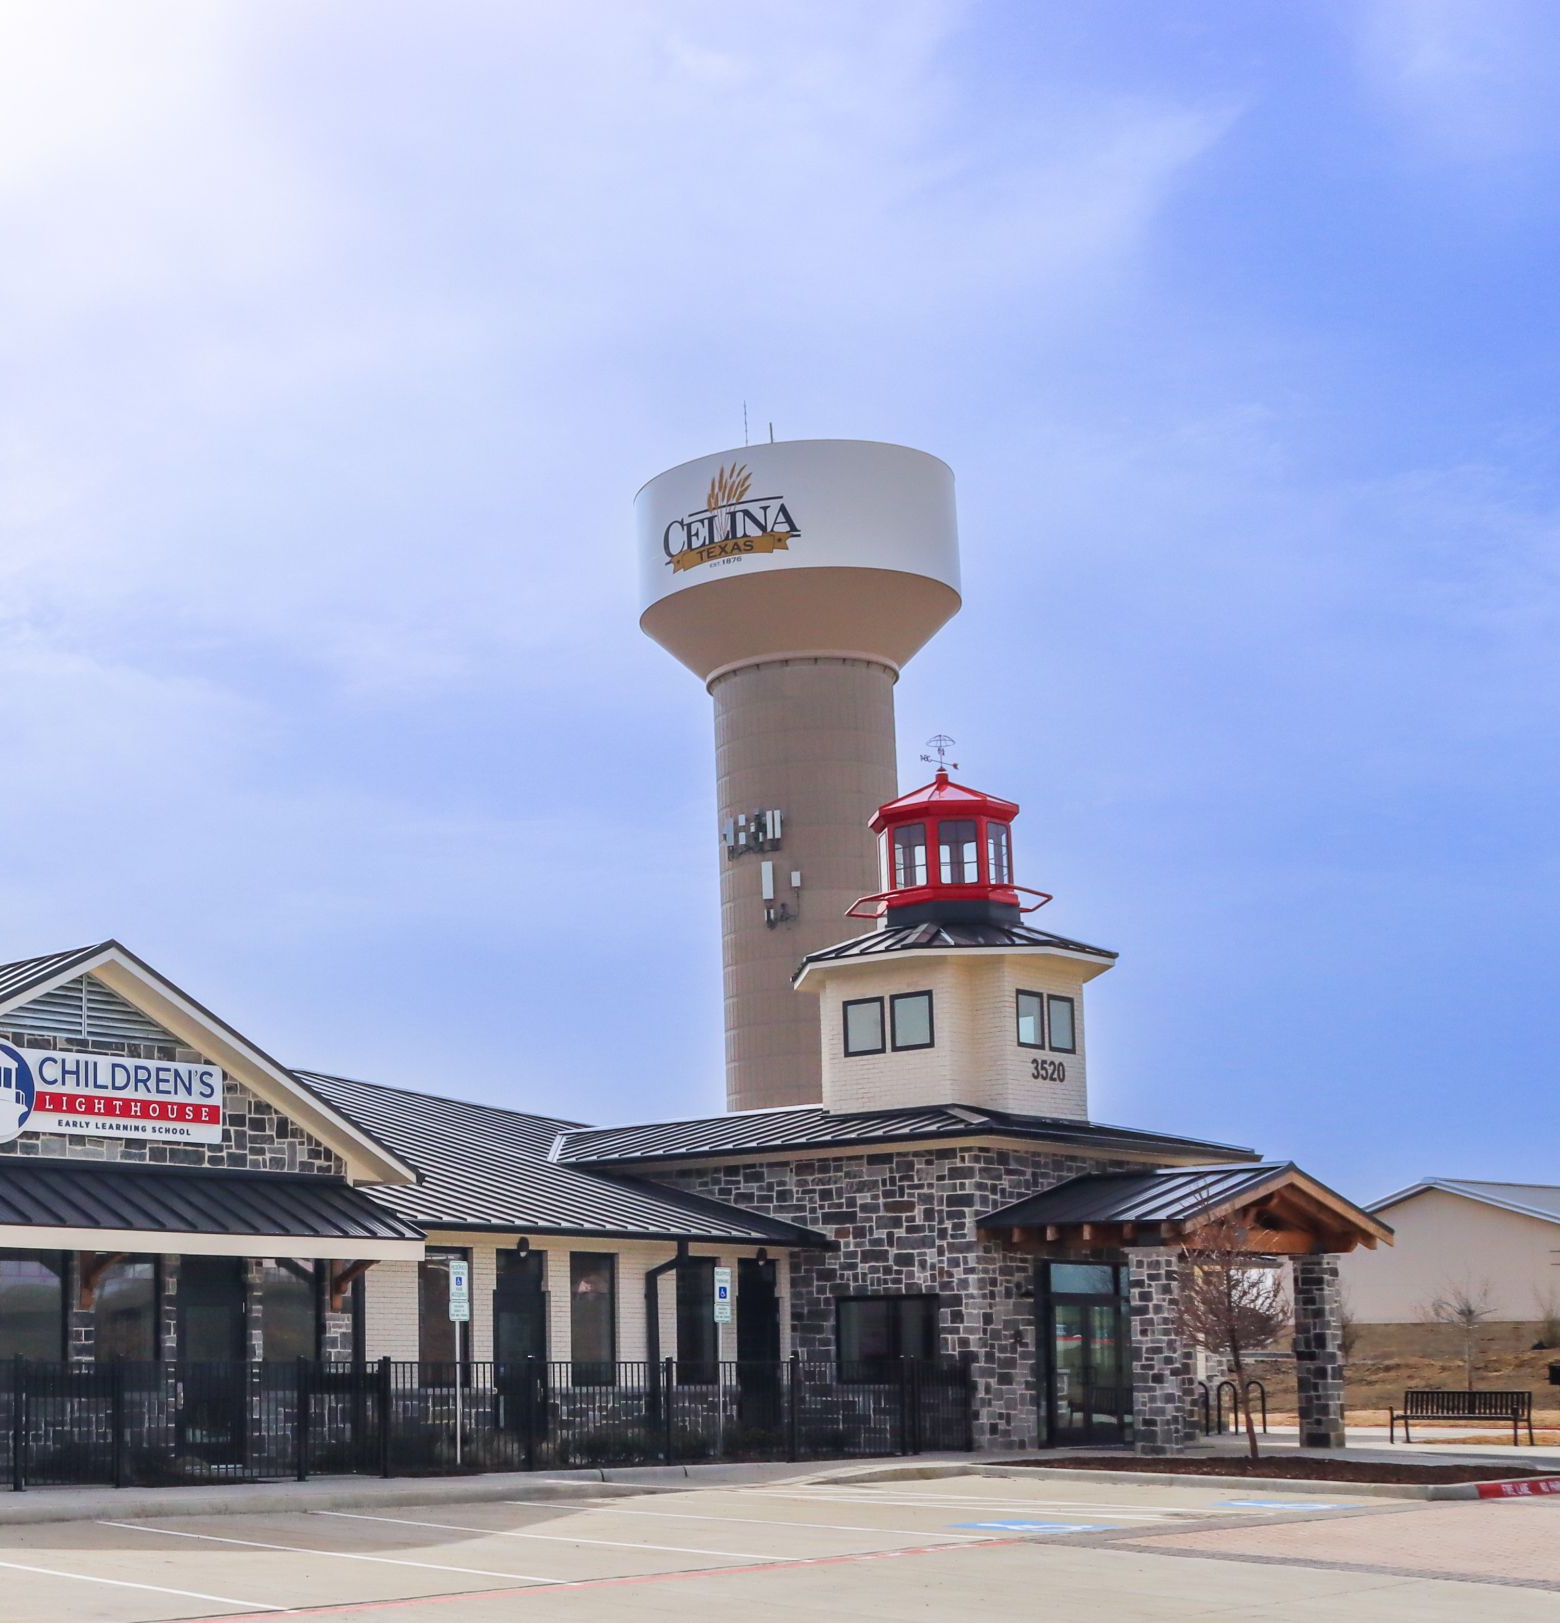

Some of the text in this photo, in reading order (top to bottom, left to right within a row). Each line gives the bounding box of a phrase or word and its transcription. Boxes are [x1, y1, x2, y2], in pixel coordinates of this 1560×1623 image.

[663, 503, 801, 558] CELINA
[696, 540, 754, 561] TEXAS
[38, 1056, 215, 1099] CHILDREN'S
[1031, 1058, 1066, 1083] 3520
[44, 1095, 209, 1121] LIGHTHOUSE
[58, 1119, 191, 1136] EARLY LEARNING SCHOOL
